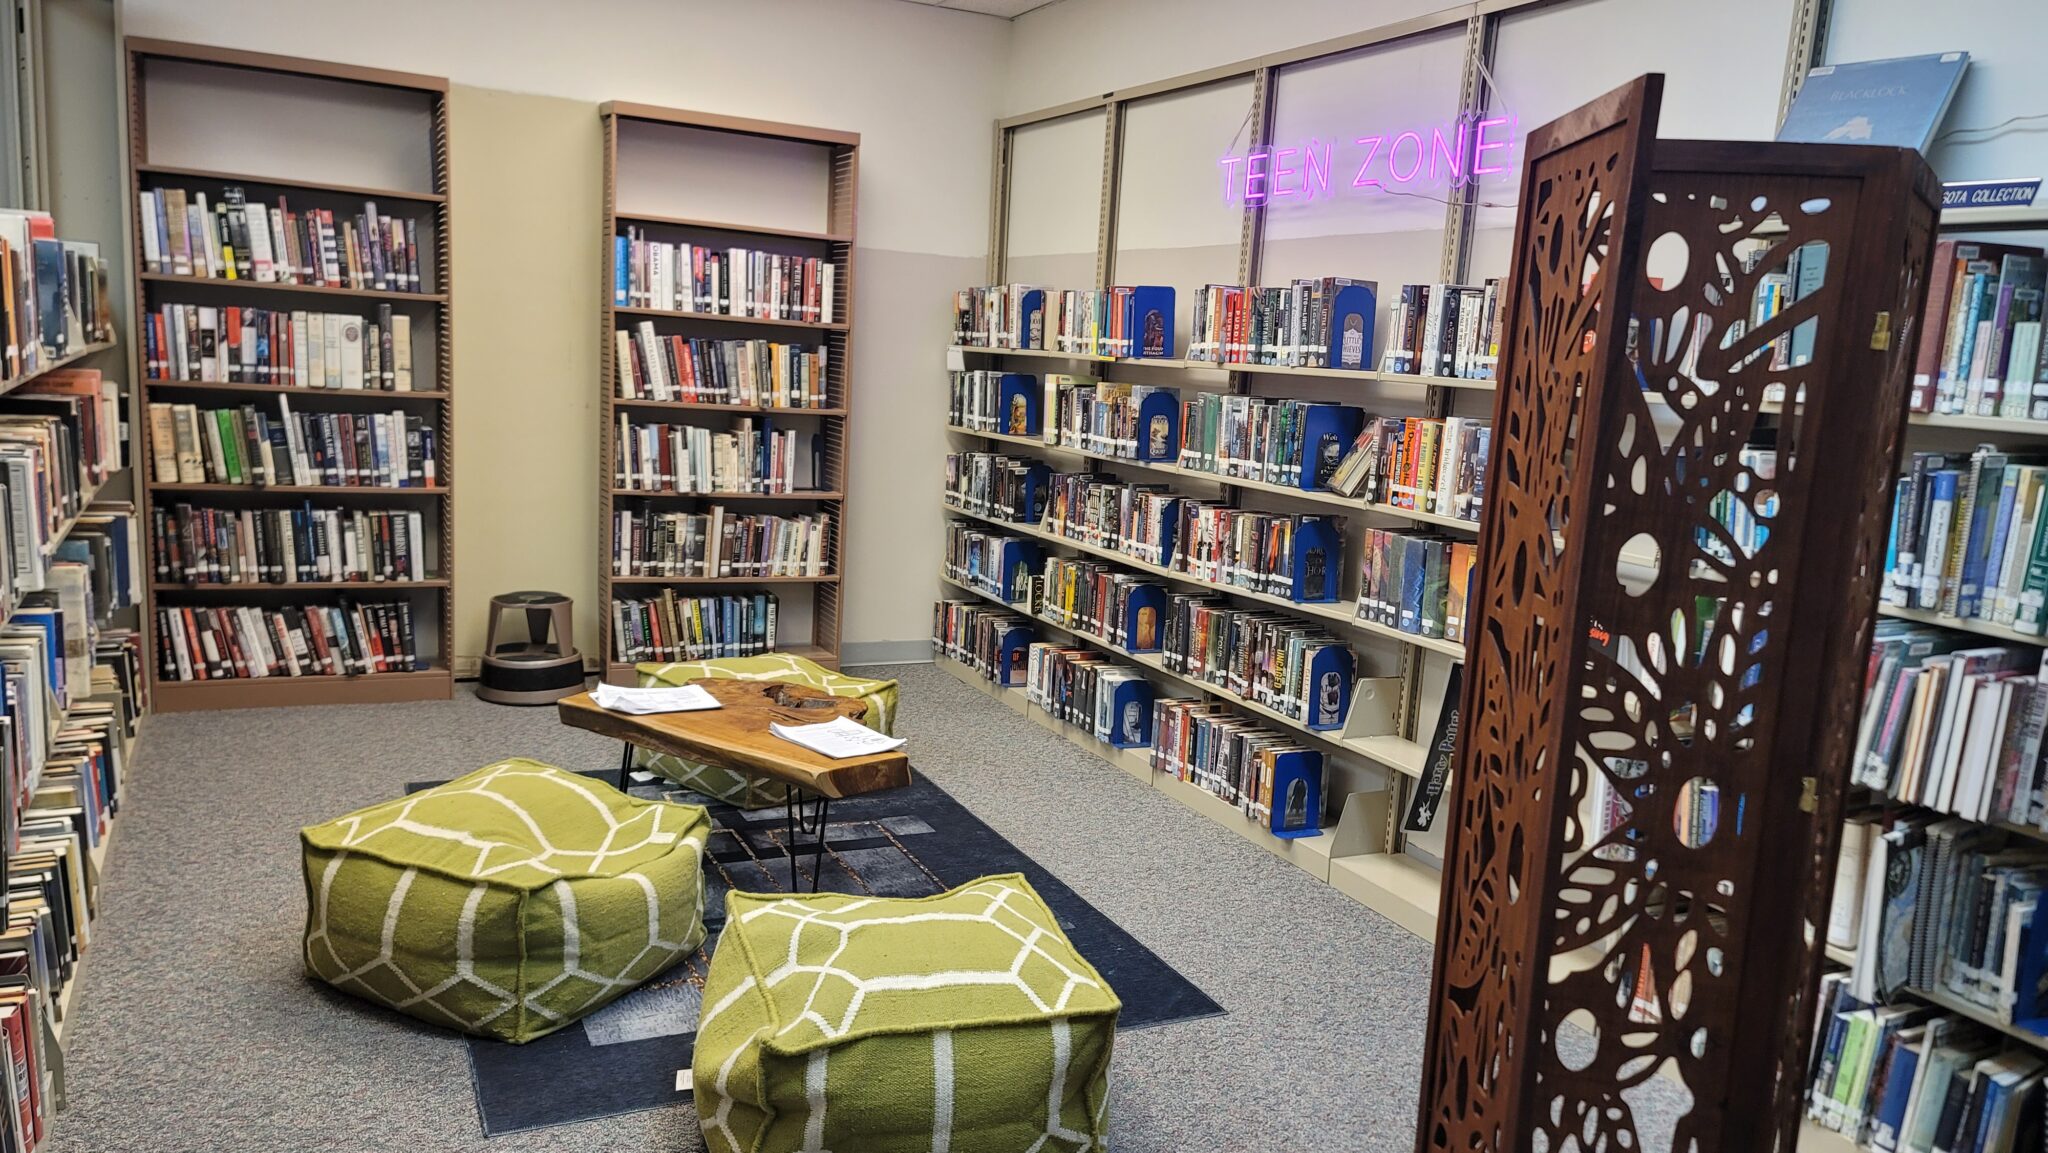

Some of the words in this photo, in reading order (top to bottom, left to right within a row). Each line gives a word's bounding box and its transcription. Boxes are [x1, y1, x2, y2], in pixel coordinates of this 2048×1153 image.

[1220, 143, 1332, 201] TEEN
[1353, 117, 1509, 187] ZONE
[1942, 190, 1967, 205] SOTA
[1971, 186, 2035, 203] COLLECTION
[652, 245, 660, 276] OBAMA
[1034, 580, 1044, 612] LOCKE
[1216, 636, 1224, 658] FOUR
[1274, 649, 1285, 689] UNCAGED
[1426, 754, 1448, 796] Harry
[1438, 709, 1460, 751] Potter
